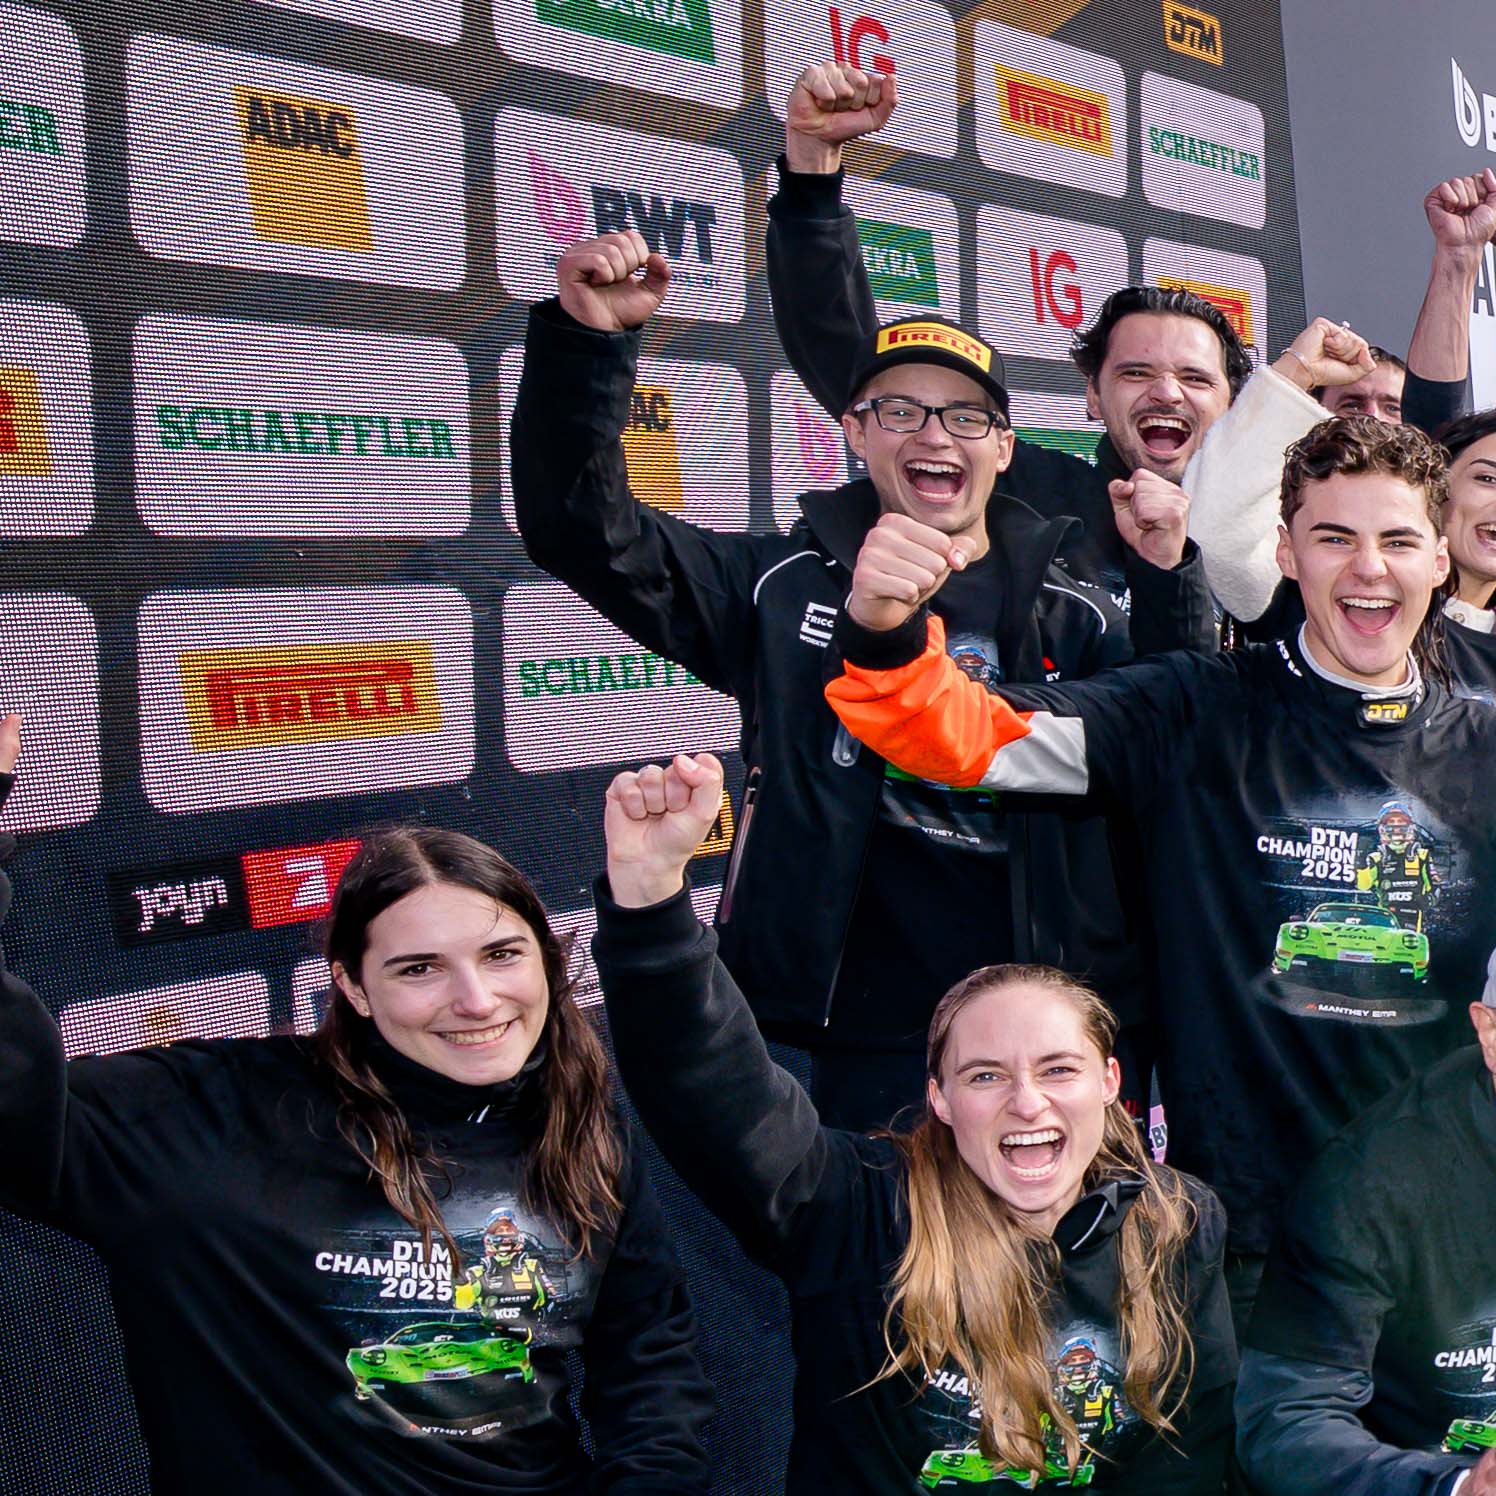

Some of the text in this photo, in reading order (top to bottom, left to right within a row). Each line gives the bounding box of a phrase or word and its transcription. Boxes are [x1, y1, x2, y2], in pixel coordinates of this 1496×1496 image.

[1170, 13, 1219, 53] DTM
[246, 96, 354, 158] ADAC
[1006, 80, 1103, 144] PIRELLI
[1148, 125, 1262, 181] SCHAEFFLER
[590, 183, 717, 265] BWT
[862, 245, 922, 281] EKRA
[1028, 247, 1084, 330] IG
[888, 326, 983, 362] PIRELLI
[155, 403, 458, 460] SCHAEFFLER
[203, 657, 418, 731] PIRELLI
[1367, 703, 1408, 720] DTM
[1256, 835, 1357, 865] CHAMPION
[1310, 826, 1358, 849] DTM
[1300, 858, 1356, 883] 2025
[131, 874, 229, 932] joyn
[1317, 1003, 1370, 1018] MANTHEY
[314, 1251, 452, 1281] CHAMPION
[392, 1240, 452, 1264] DTM
[379, 1277, 453, 1302] 2025
[420, 1426, 468, 1437] NTHEY
